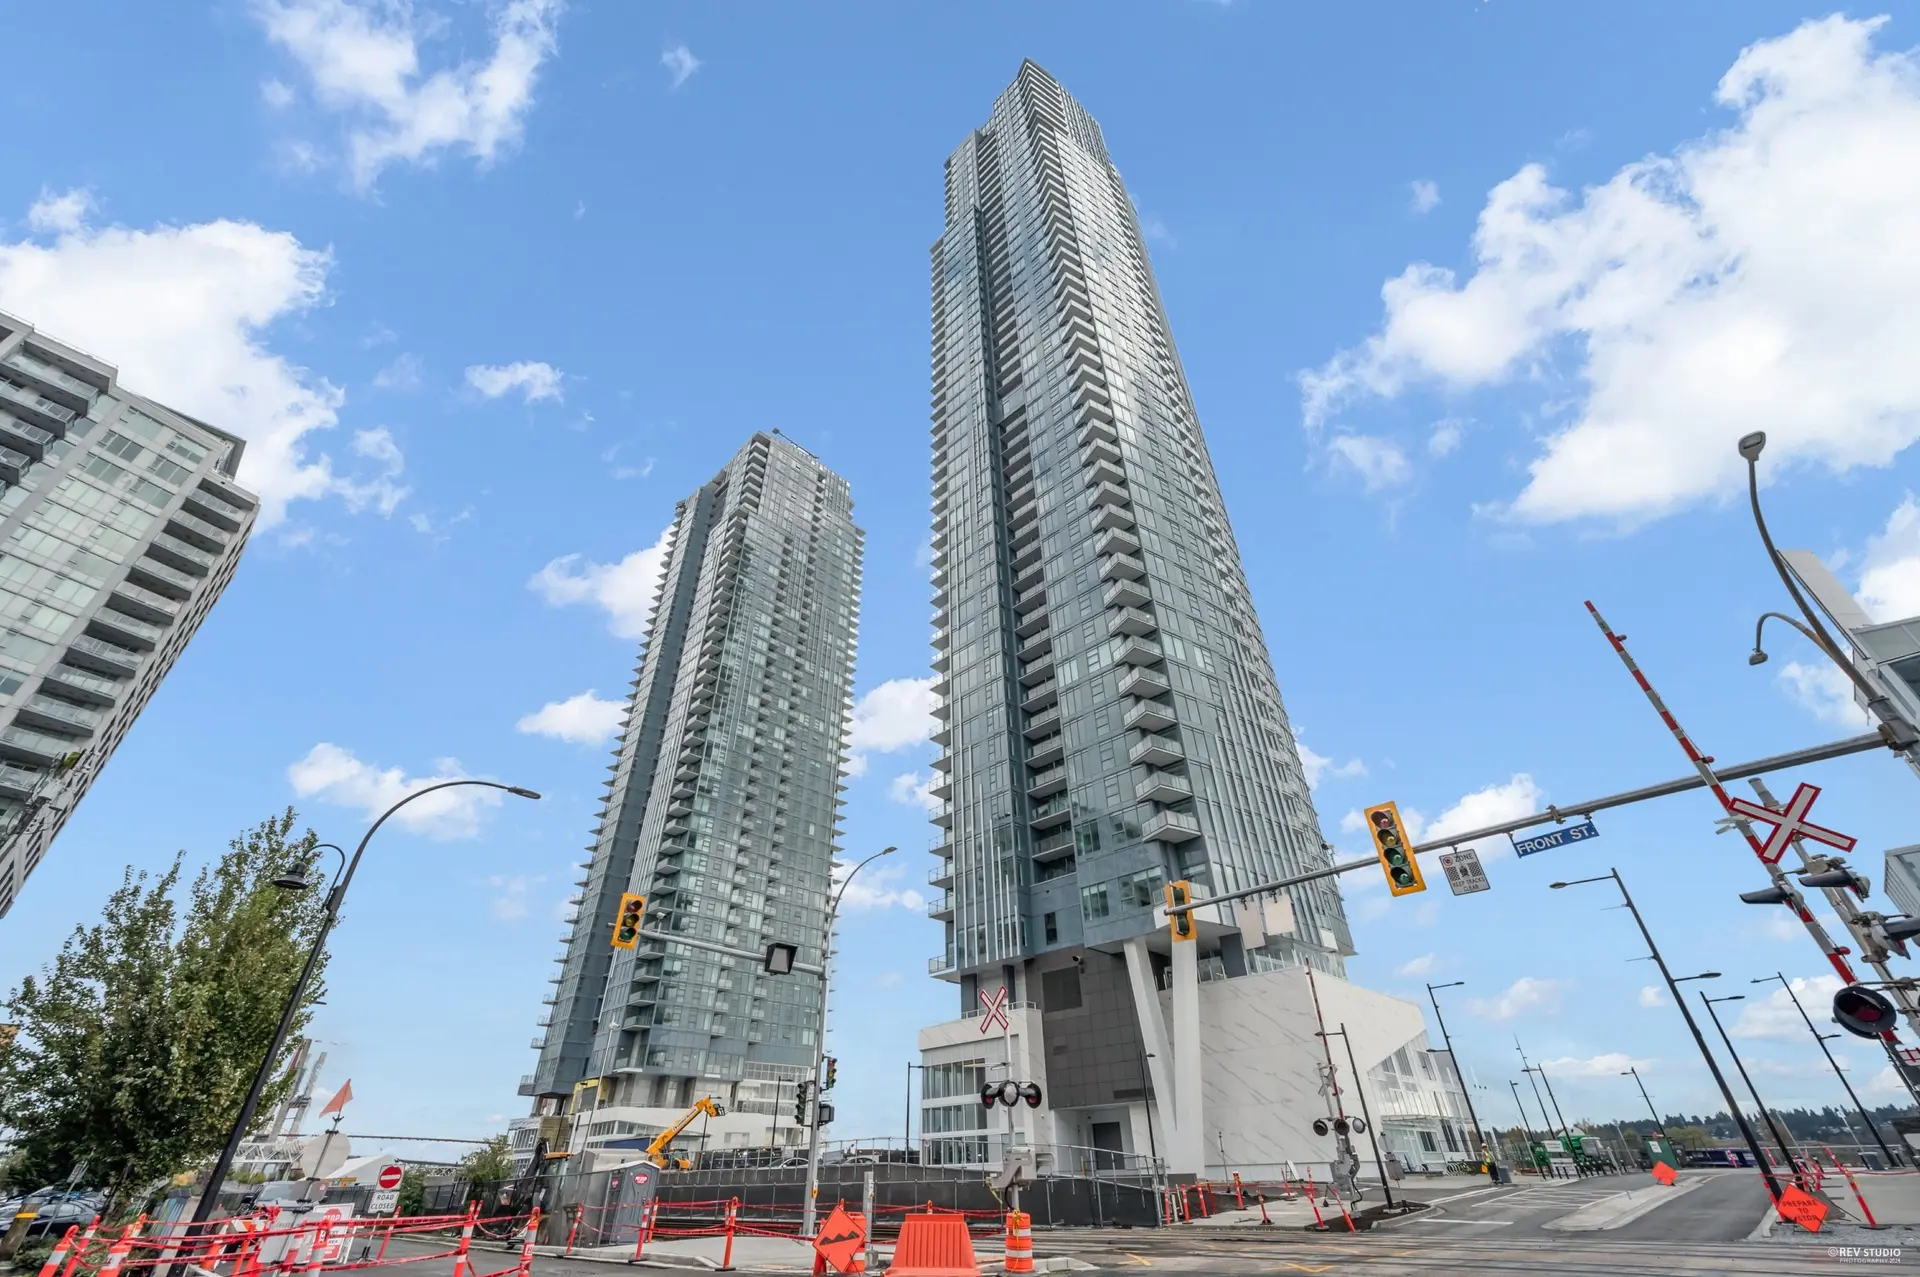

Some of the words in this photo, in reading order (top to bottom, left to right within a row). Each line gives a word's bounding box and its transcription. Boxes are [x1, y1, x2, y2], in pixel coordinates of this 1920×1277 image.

[1516, 832, 1564, 855] FRONT
[1569, 825, 1595, 840] ST.
[1455, 853, 1474, 863] ZONE
[1466, 877, 1485, 885] TRACKS
[1463, 884, 1480, 892] CLEAR
[1782, 1199, 1819, 1208] PREPARE
